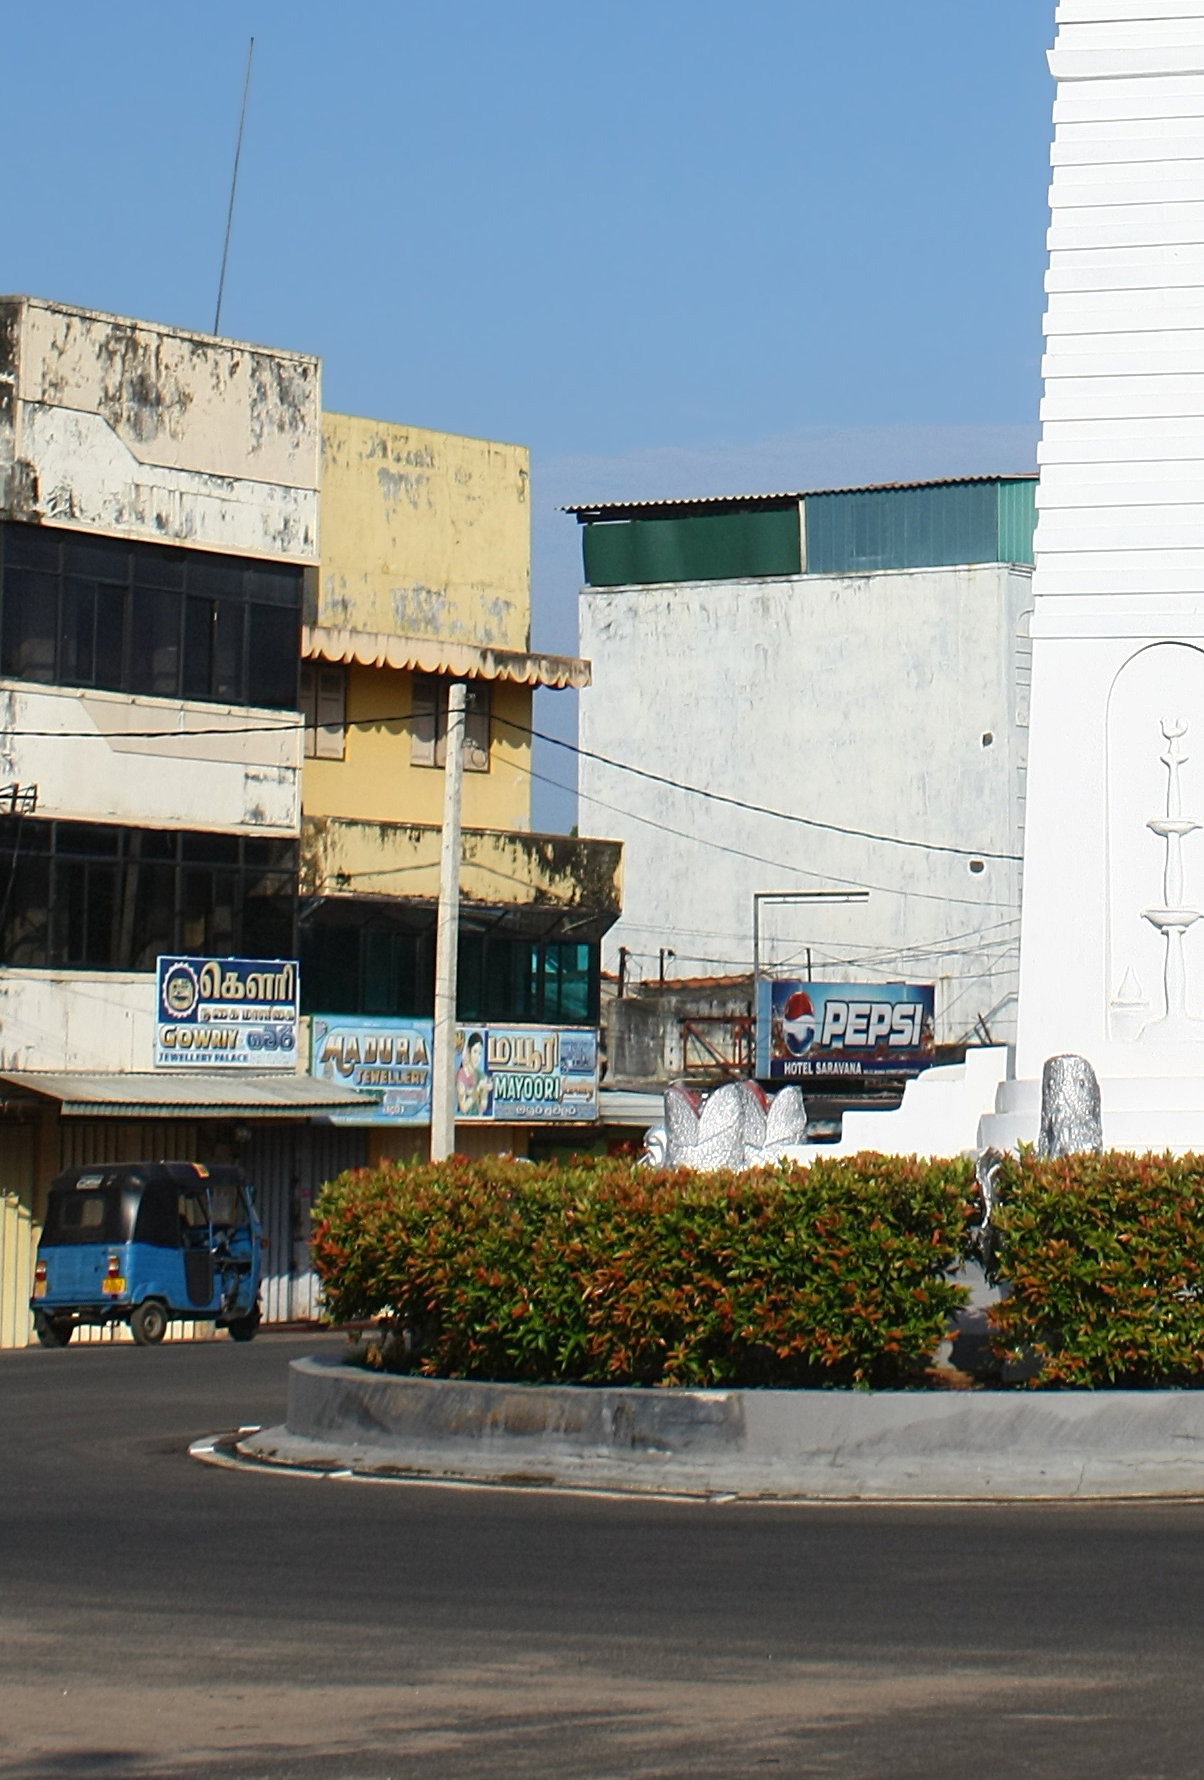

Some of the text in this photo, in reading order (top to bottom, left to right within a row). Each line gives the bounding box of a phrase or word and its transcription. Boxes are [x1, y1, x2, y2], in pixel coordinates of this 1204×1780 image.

[820, 1000, 924, 1048] PEPSI
[160, 1025, 239, 1050] GOWRIY
[214, 1053, 249, 1062] PALACE
[320, 1034, 429, 1078] MADURA
[784, 1061, 812, 1075] HOTEL
[815, 1061, 863, 1075] SARAVANA
[355, 1069, 428, 1086] JEWELLERY
[494, 1075, 560, 1100] MAYOORI
